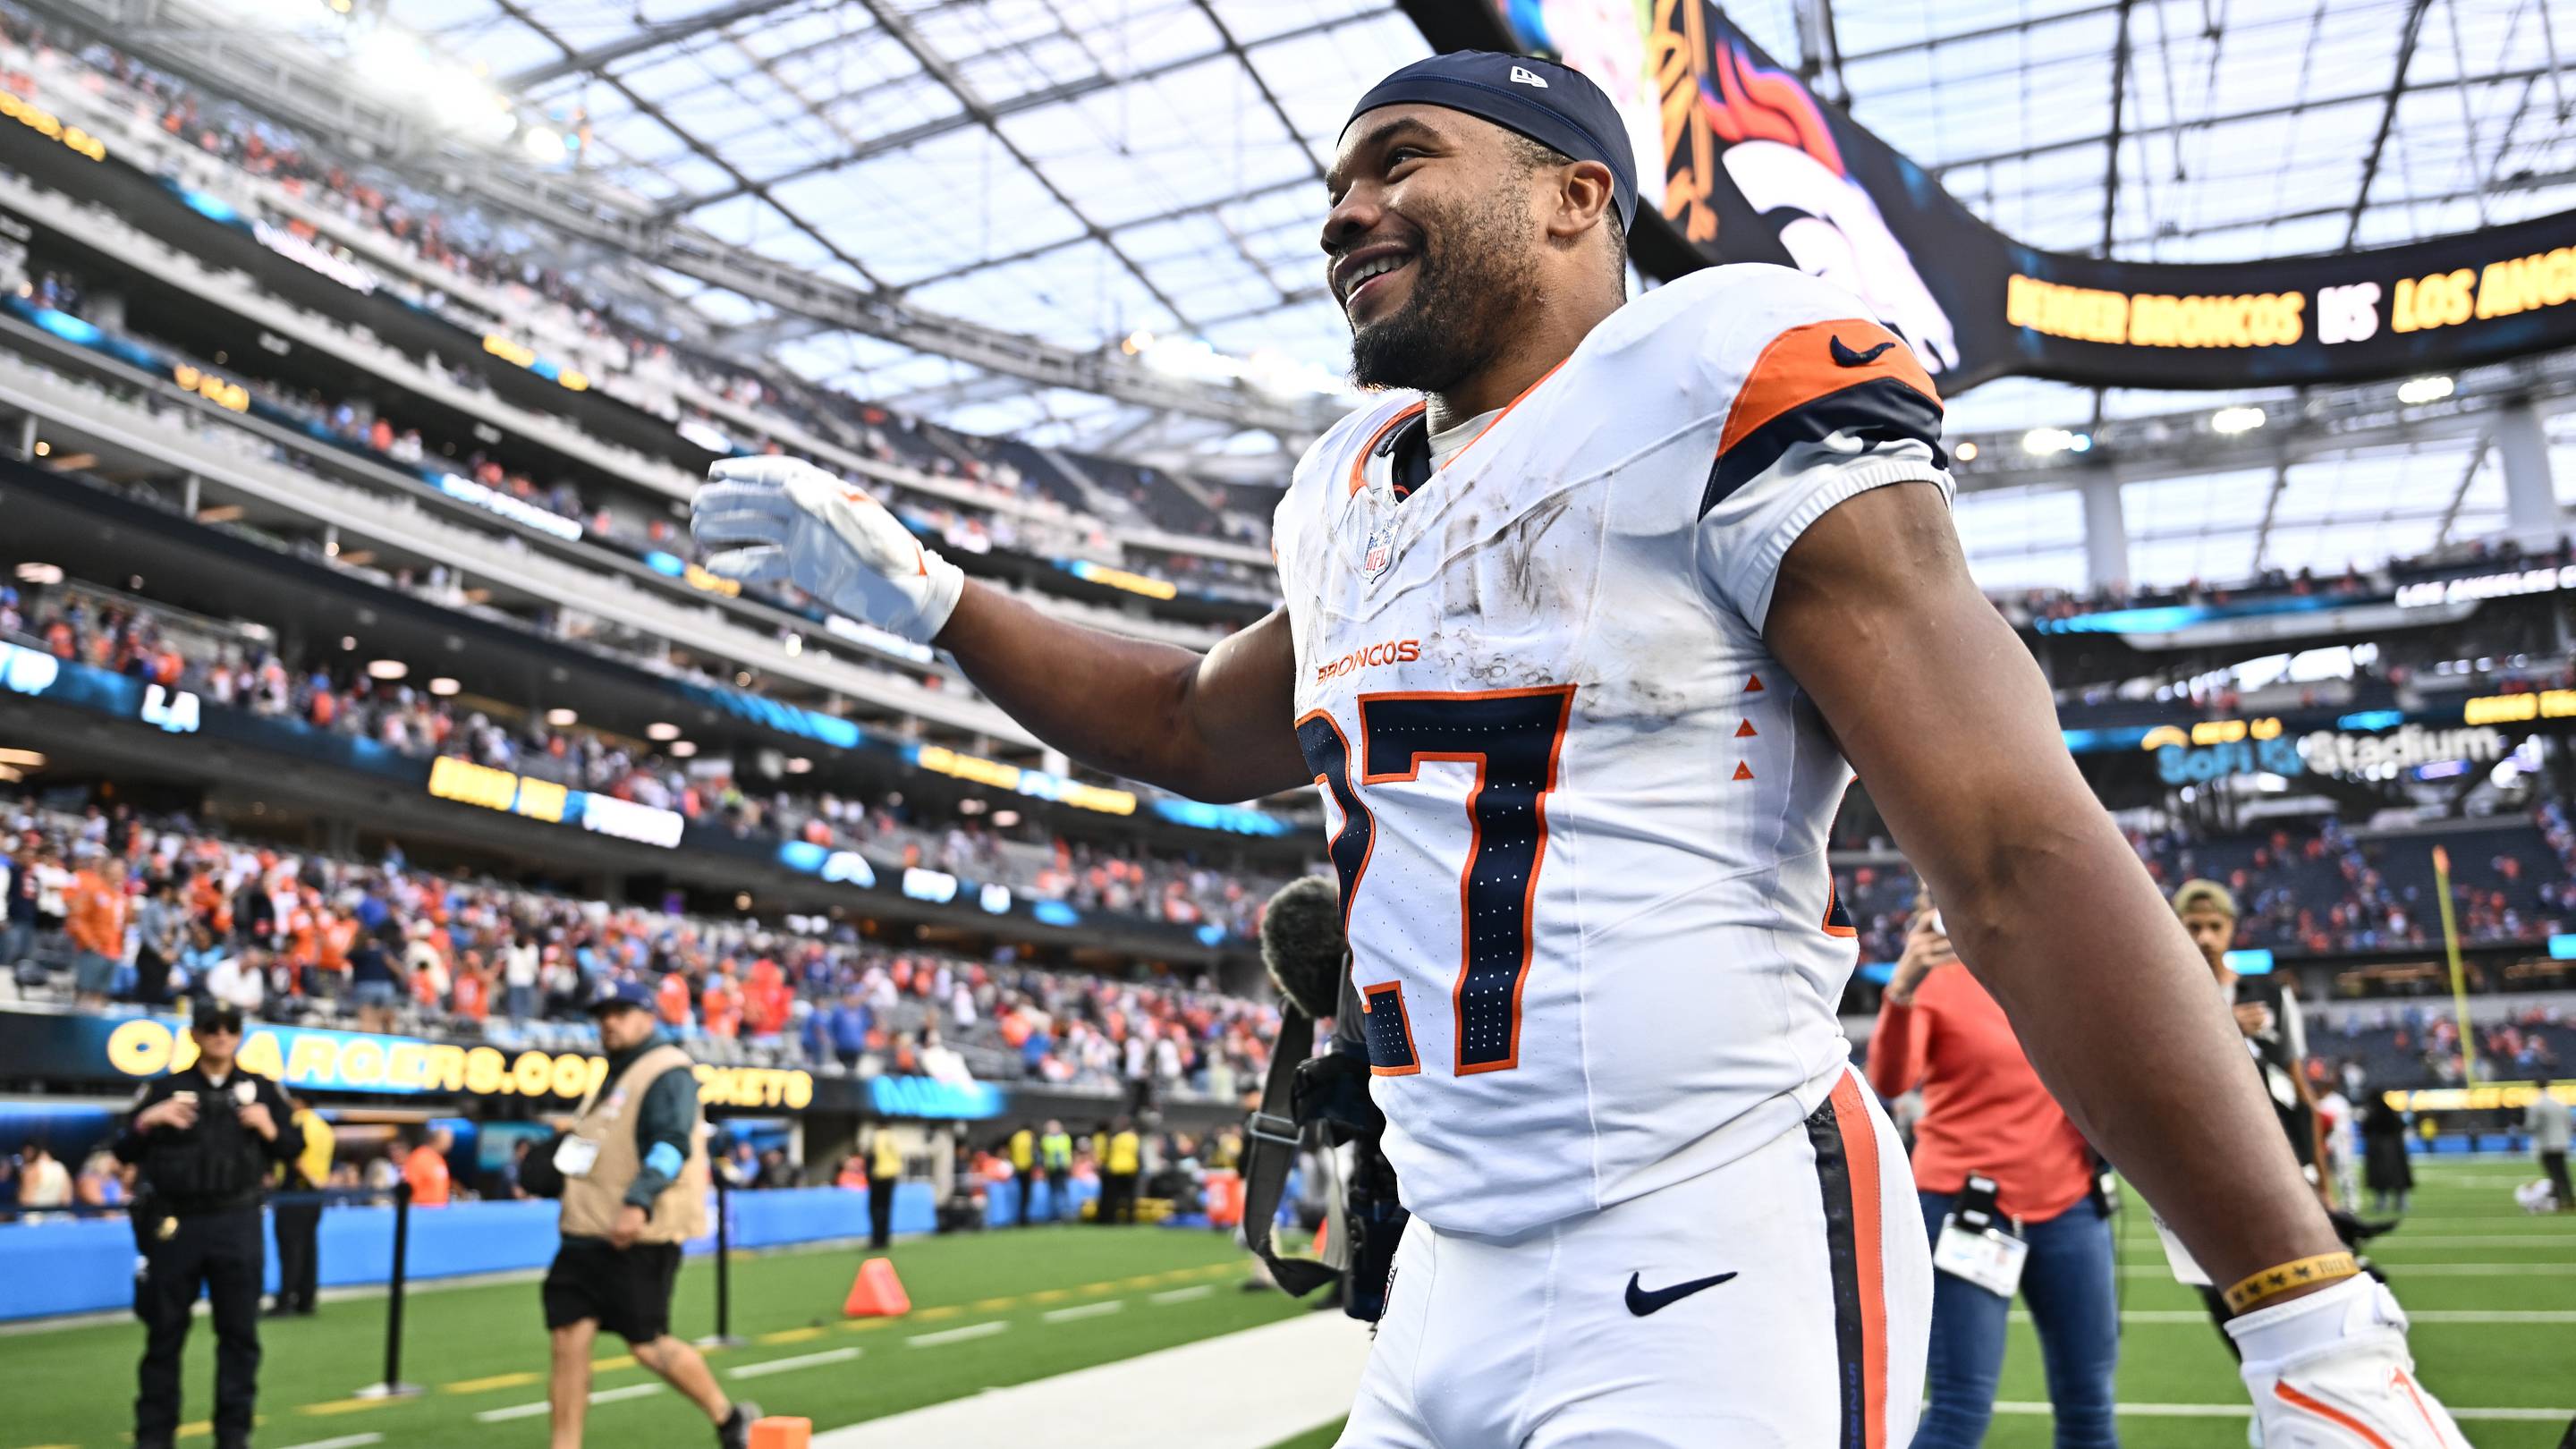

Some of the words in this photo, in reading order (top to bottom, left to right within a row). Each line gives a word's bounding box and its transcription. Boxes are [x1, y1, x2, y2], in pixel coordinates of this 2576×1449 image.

[2128, 292, 2306, 349] BRONCOS
[2317, 281, 2382, 345] VS
[2391, 267, 2477, 334] LOS
[2475, 244, 2576, 320] ANG
[1364, 546, 1386, 571] NFL
[1315, 639, 1420, 687] BRONCOS
[2306, 723, 2503, 775] Stadium
[1295, 684, 1578, 1077] 27
